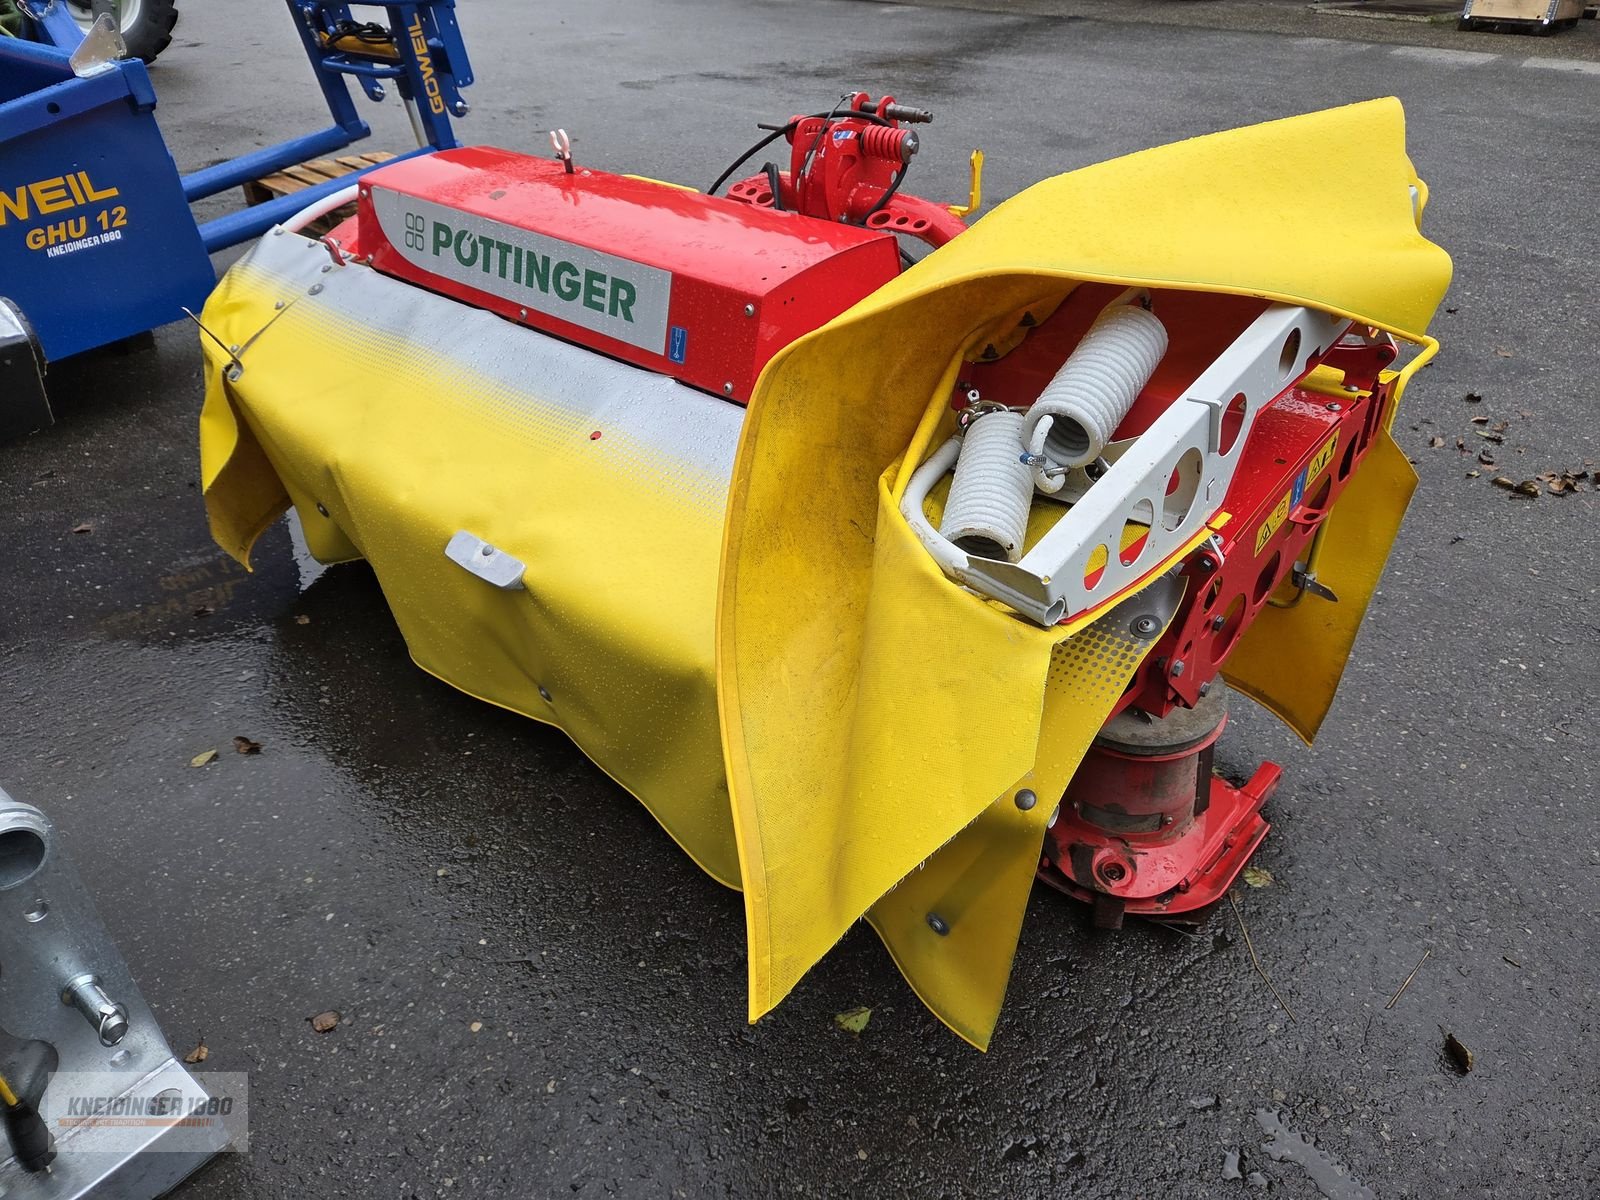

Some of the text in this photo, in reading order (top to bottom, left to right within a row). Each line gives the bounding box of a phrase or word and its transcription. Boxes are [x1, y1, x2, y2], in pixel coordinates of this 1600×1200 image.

[26, 206, 127, 250] GHU 12
[46, 229, 122, 258] KNEIDINGER 1880
[432, 221, 637, 323] PÖTTINGER
